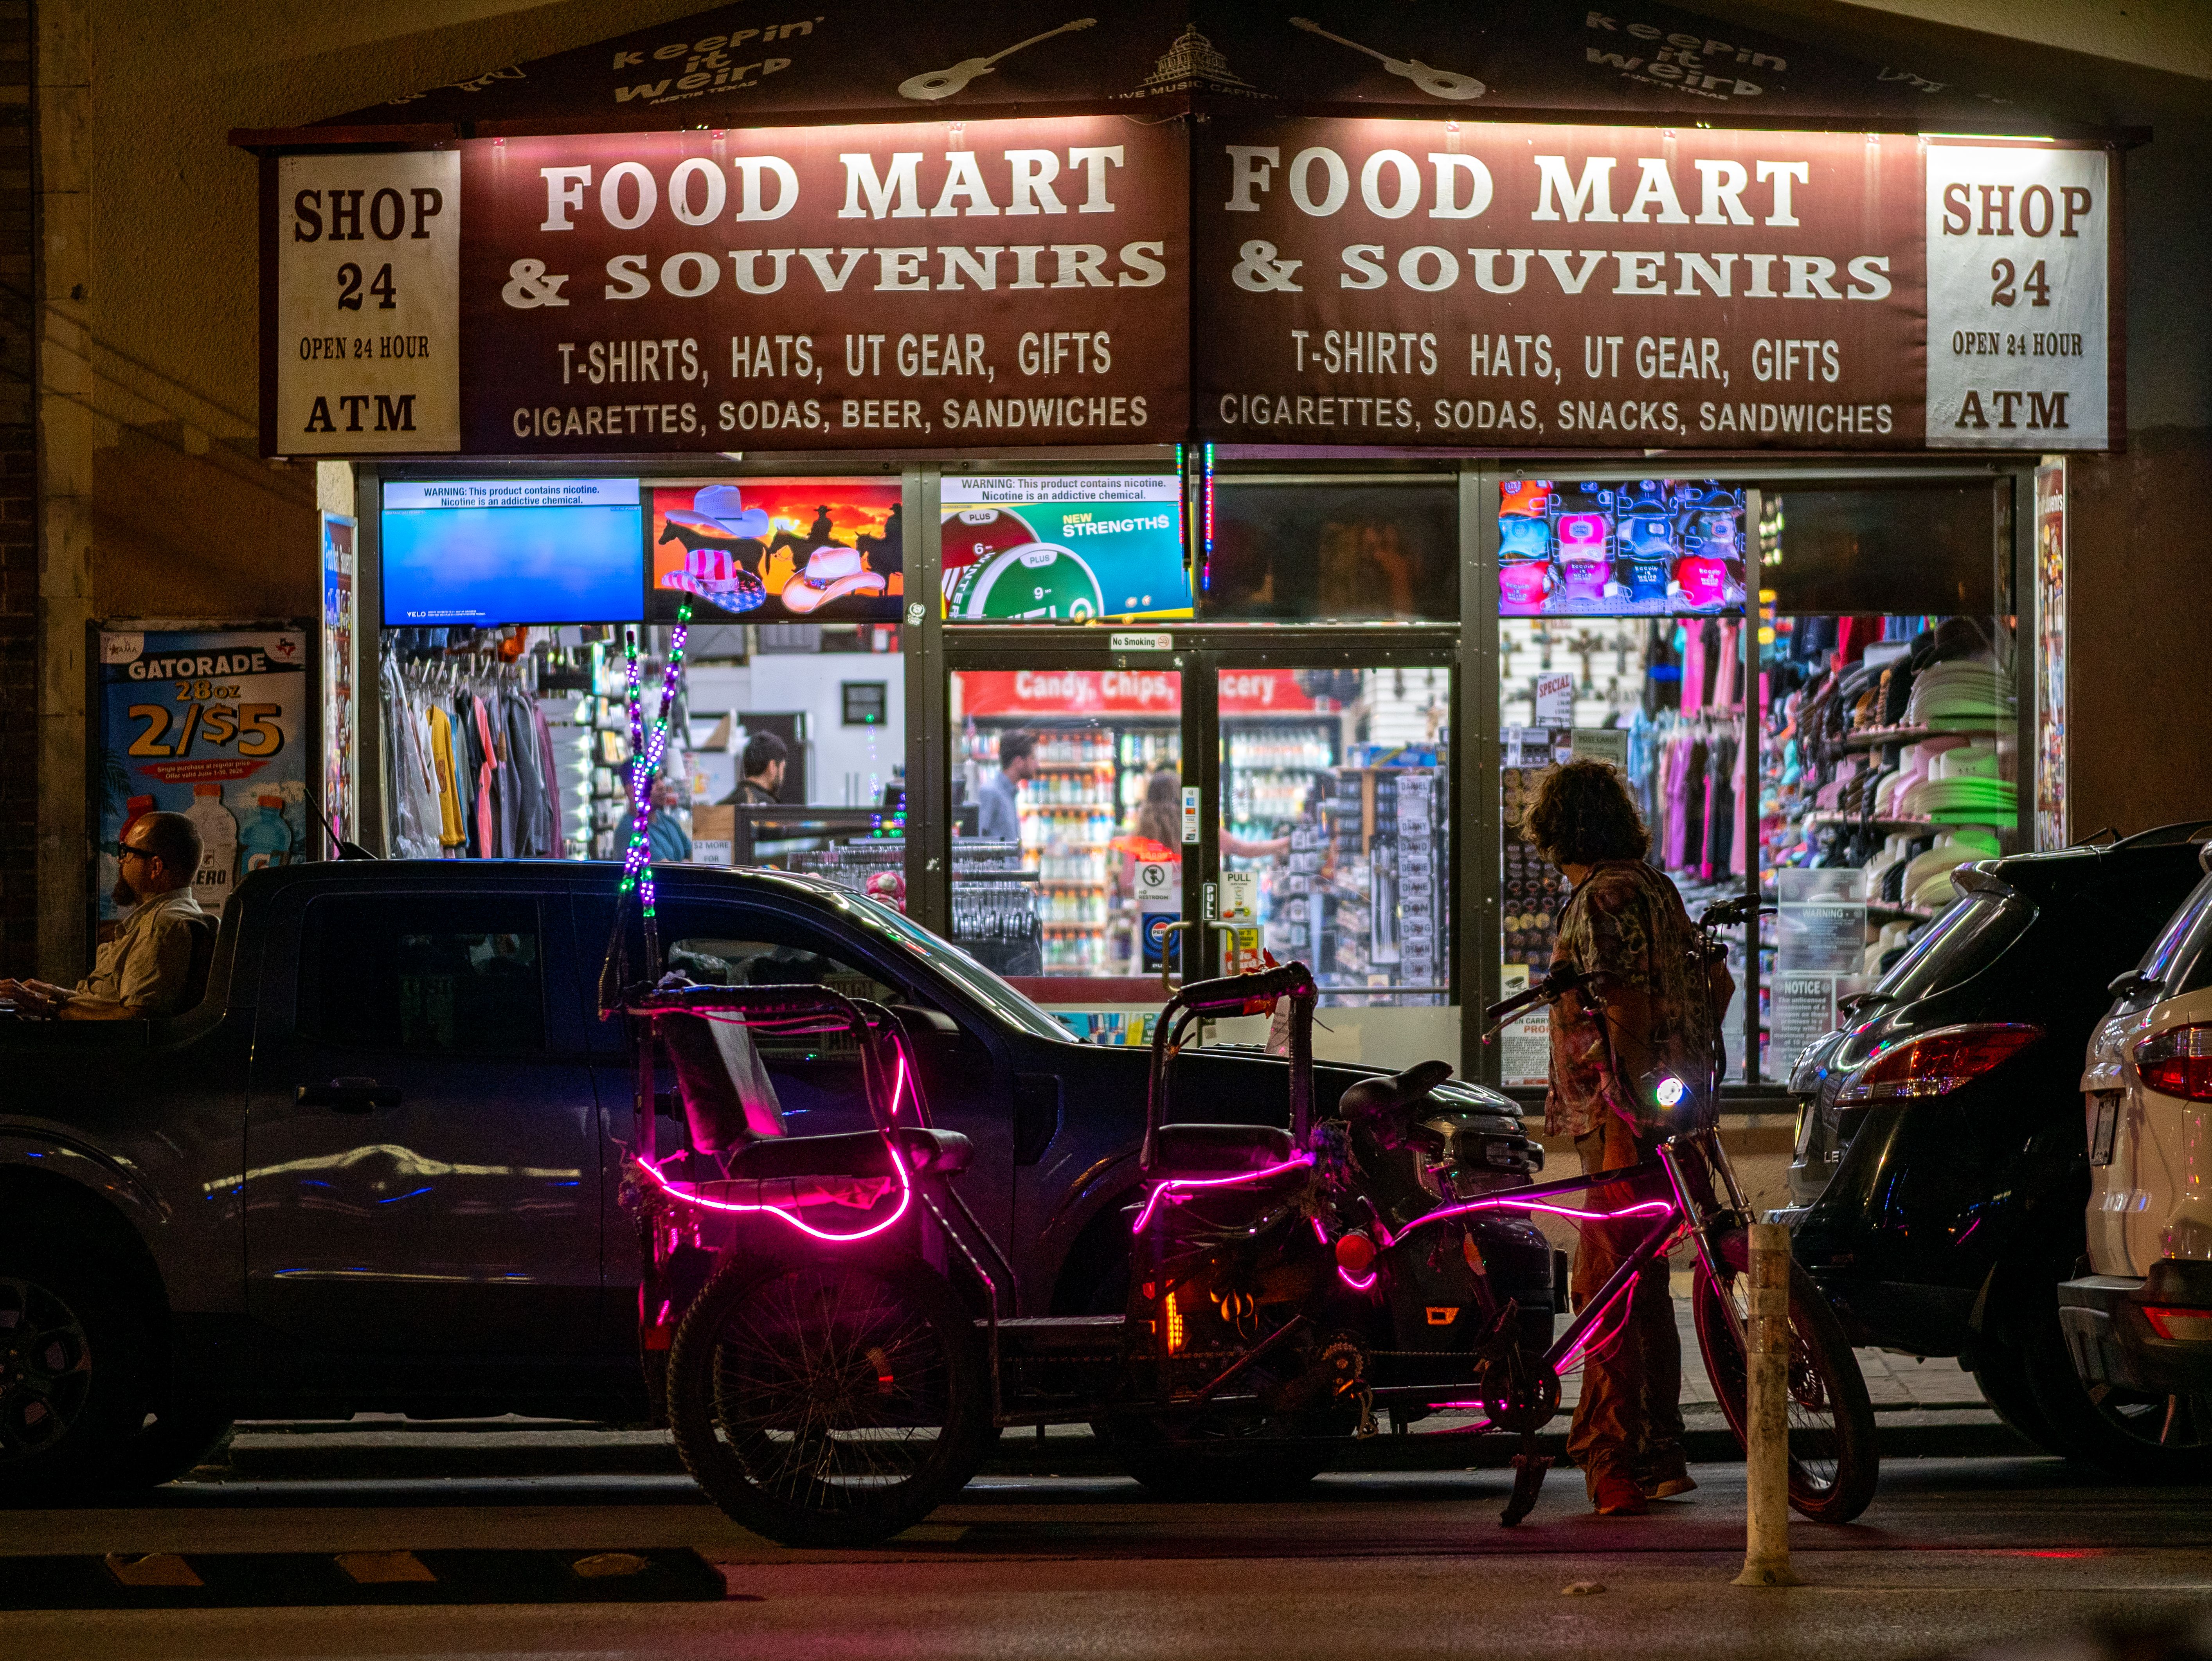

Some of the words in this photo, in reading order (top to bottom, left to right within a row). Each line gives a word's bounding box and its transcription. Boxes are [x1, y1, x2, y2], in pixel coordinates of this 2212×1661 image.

[649, 91, 704, 105] AUSTIN
[707, 80, 758, 94] TEXAS
[1150, 80, 1204, 95] MUSIC
[540, 155, 799, 232] FOOD
[838, 145, 1124, 219] MART
[1225, 145, 1493, 219] FOOD
[1531, 155, 1809, 226] MART
[294, 187, 443, 243] SHOP
[1943, 183, 2093, 237] SHOP
[502, 258, 570, 308] &
[605, 240, 1167, 300] SOUVENIRS
[1231, 239, 1303, 292] &
[1341, 244, 1893, 300] SOUVENIRS
[1991, 257, 2050, 307] 24
[337, 262, 396, 311] 24
[299, 337, 346, 360] OPEN
[354, 338, 373, 358] 24
[380, 335, 430, 358] HOUR
[1952, 330, 1999, 355] OPEN
[2007, 331, 2026, 355] 24
[2033, 332, 2083, 356] HOUR
[558, 337, 709, 388] T-SHIRTS,
[732, 333, 823, 385] HATS,
[845, 334, 885, 377] UT
[896, 332, 995, 382] GEAR,
[1017, 330, 1110, 376] GIFTS
[1292, 329, 1438, 376] T-SHIRTS
[1471, 335, 1561, 385] HATS,
[1585, 335, 1624, 378] UT
[1635, 337, 1730, 388] GEAR,
[1751, 338, 1840, 382] GIFTS
[304, 394, 416, 433] ATM
[513, 402, 707, 438] CIGARETTES,
[718, 398, 830, 434] SODAS,
[842, 398, 931, 434] BEER,
[942, 395, 1147, 429] SANDWICHES
[1220, 392, 1422, 433] CIGARETTES,
[1434, 400, 1545, 434] SODAS,
[1558, 400, 1686, 435] SNACKS,
[1699, 400, 1893, 434] SANDWICHES
[1955, 390, 2070, 429] ATM
[424, 487, 467, 497] WARNING:
[469, 487, 487, 496] This
[489, 486, 522, 497] product
[525, 485, 560, 495] contains
[563, 485, 599, 494] nicotine.
[962, 479, 1015, 489] WARNING:
[1018, 479, 1038, 488] This
[1041, 479, 1078, 490] product
[1080, 478, 1121, 488] contains
[1124, 478, 1166, 488] nicotine.
[982, 490, 1024, 500] Nicotine
[1026, 490, 1034, 500] is
[1051, 490, 1096, 500] addictive
[1098, 489, 1146, 499] chemical.
[441, 497, 476, 506] Nicotine
[478, 497, 485, 506] is
[501, 496, 540, 505] addictive
[542, 495, 583, 504] chemical.
[969, 513, 991, 521] PLUS
[1063, 513, 1092, 524] NEW
[1063, 515, 1170, 538] STRENGTHS
[974, 543, 984, 555] 6
[1029, 554, 1050, 564] PLUS
[952, 552, 996, 618] WINTER
[1034, 587, 1044, 599] 9
[1112, 637, 1122, 646] No
[1124, 637, 1155, 648] Smoking
[128, 653, 267, 680] GATORADE
[1017, 671, 1095, 704] Candy,
[1102, 671, 1174, 704] Chips,
[1539, 674, 1570, 698] SPECIAL
[128, 703, 284, 758] 2/$5
[694, 841, 703, 849] $2
[192, 870, 226, 885] ERO
[1227, 873, 1251, 882] PULL
[1803, 908, 1843, 918] WARNING
[1785, 981, 1820, 995] NOTICE
[1824, 1151, 1839, 1163] LE
